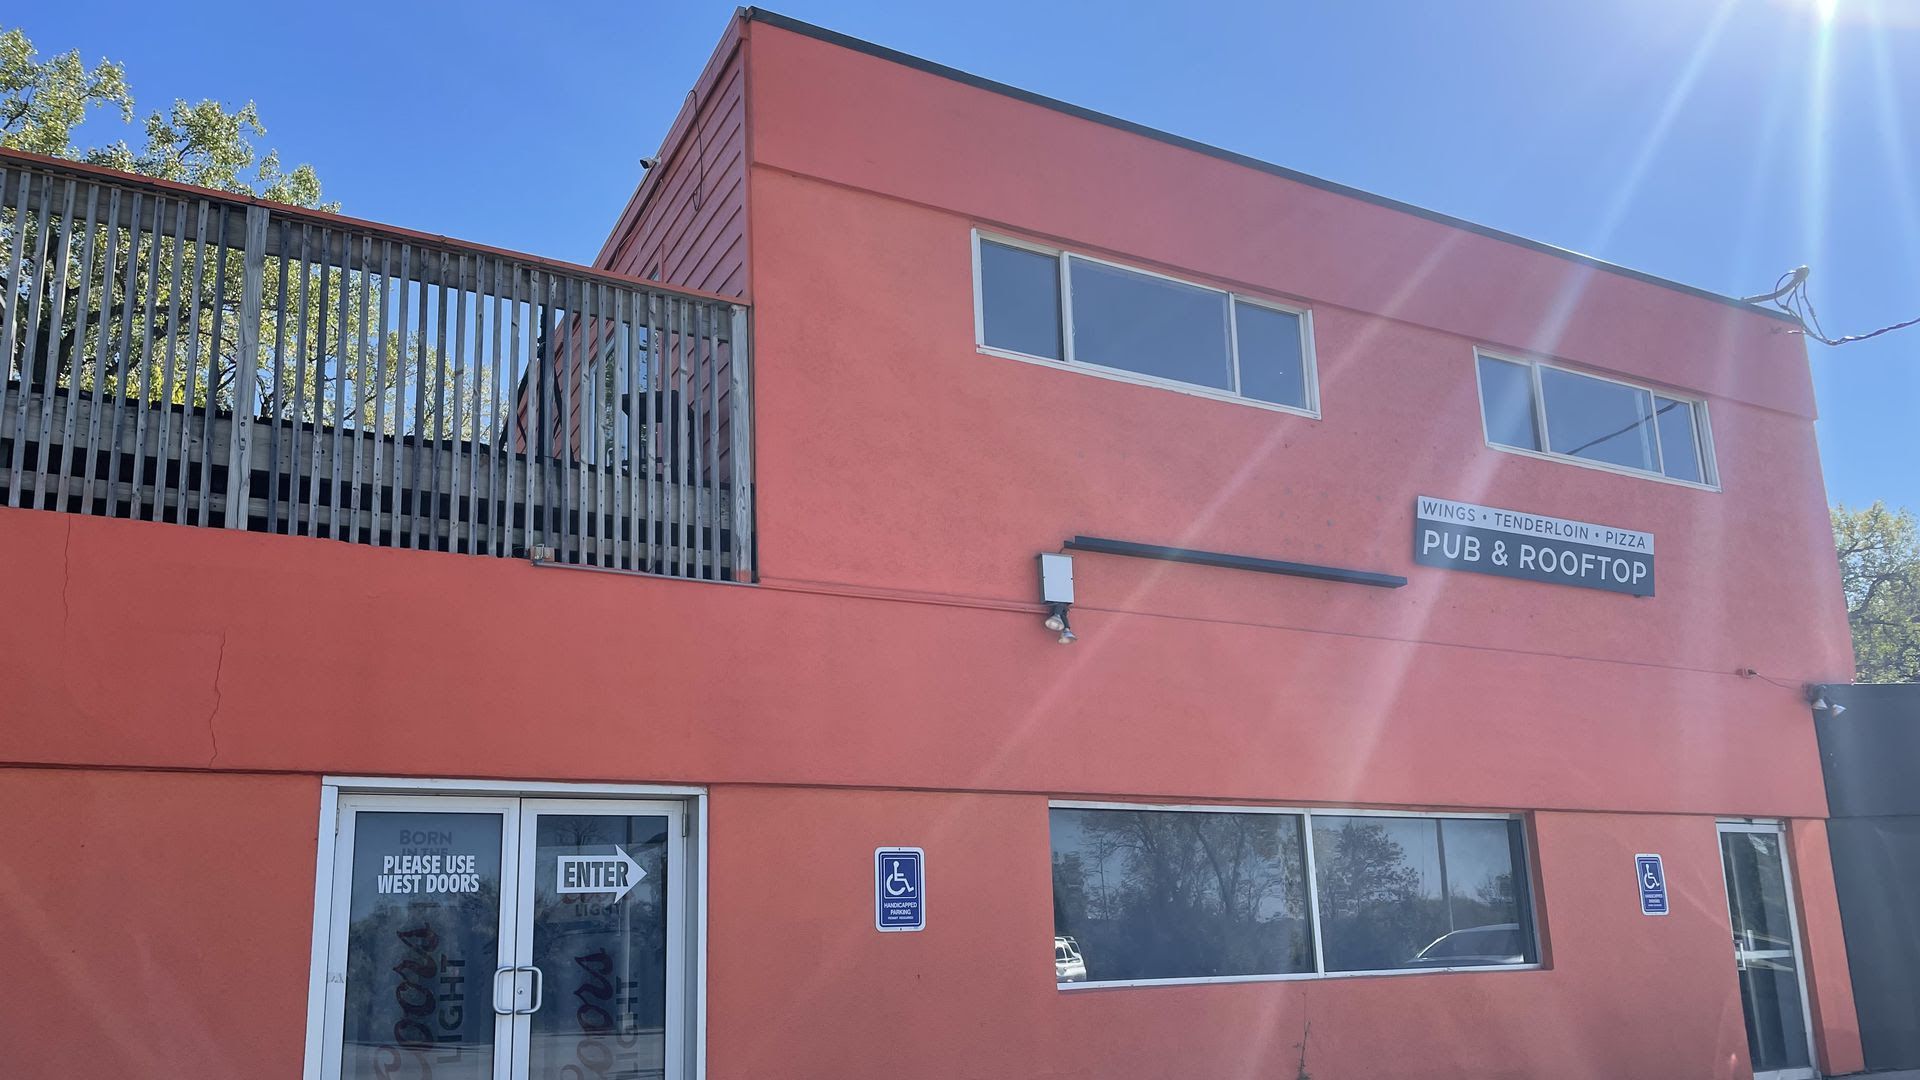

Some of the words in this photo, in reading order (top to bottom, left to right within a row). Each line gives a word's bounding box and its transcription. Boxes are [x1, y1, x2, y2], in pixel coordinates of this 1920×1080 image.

[1422, 500, 1476, 522] WINGS
[1494, 512, 1589, 540] TENDERLOIN
[1605, 530, 1646, 550] PIZZA
[1423, 529, 1481, 562] PUB
[1491, 540, 1508, 567] &
[1519, 543, 1647, 585] ROOFTOP
[400, 829, 453, 846] BORN
[383, 855, 441, 875] PLEASE
[445, 855, 475, 874] USE
[563, 861, 629, 888] ENTER
[377, 874, 421, 894] WEST
[425, 874, 480, 893] DOORS
[436, 953, 466, 1064] LIGHT
